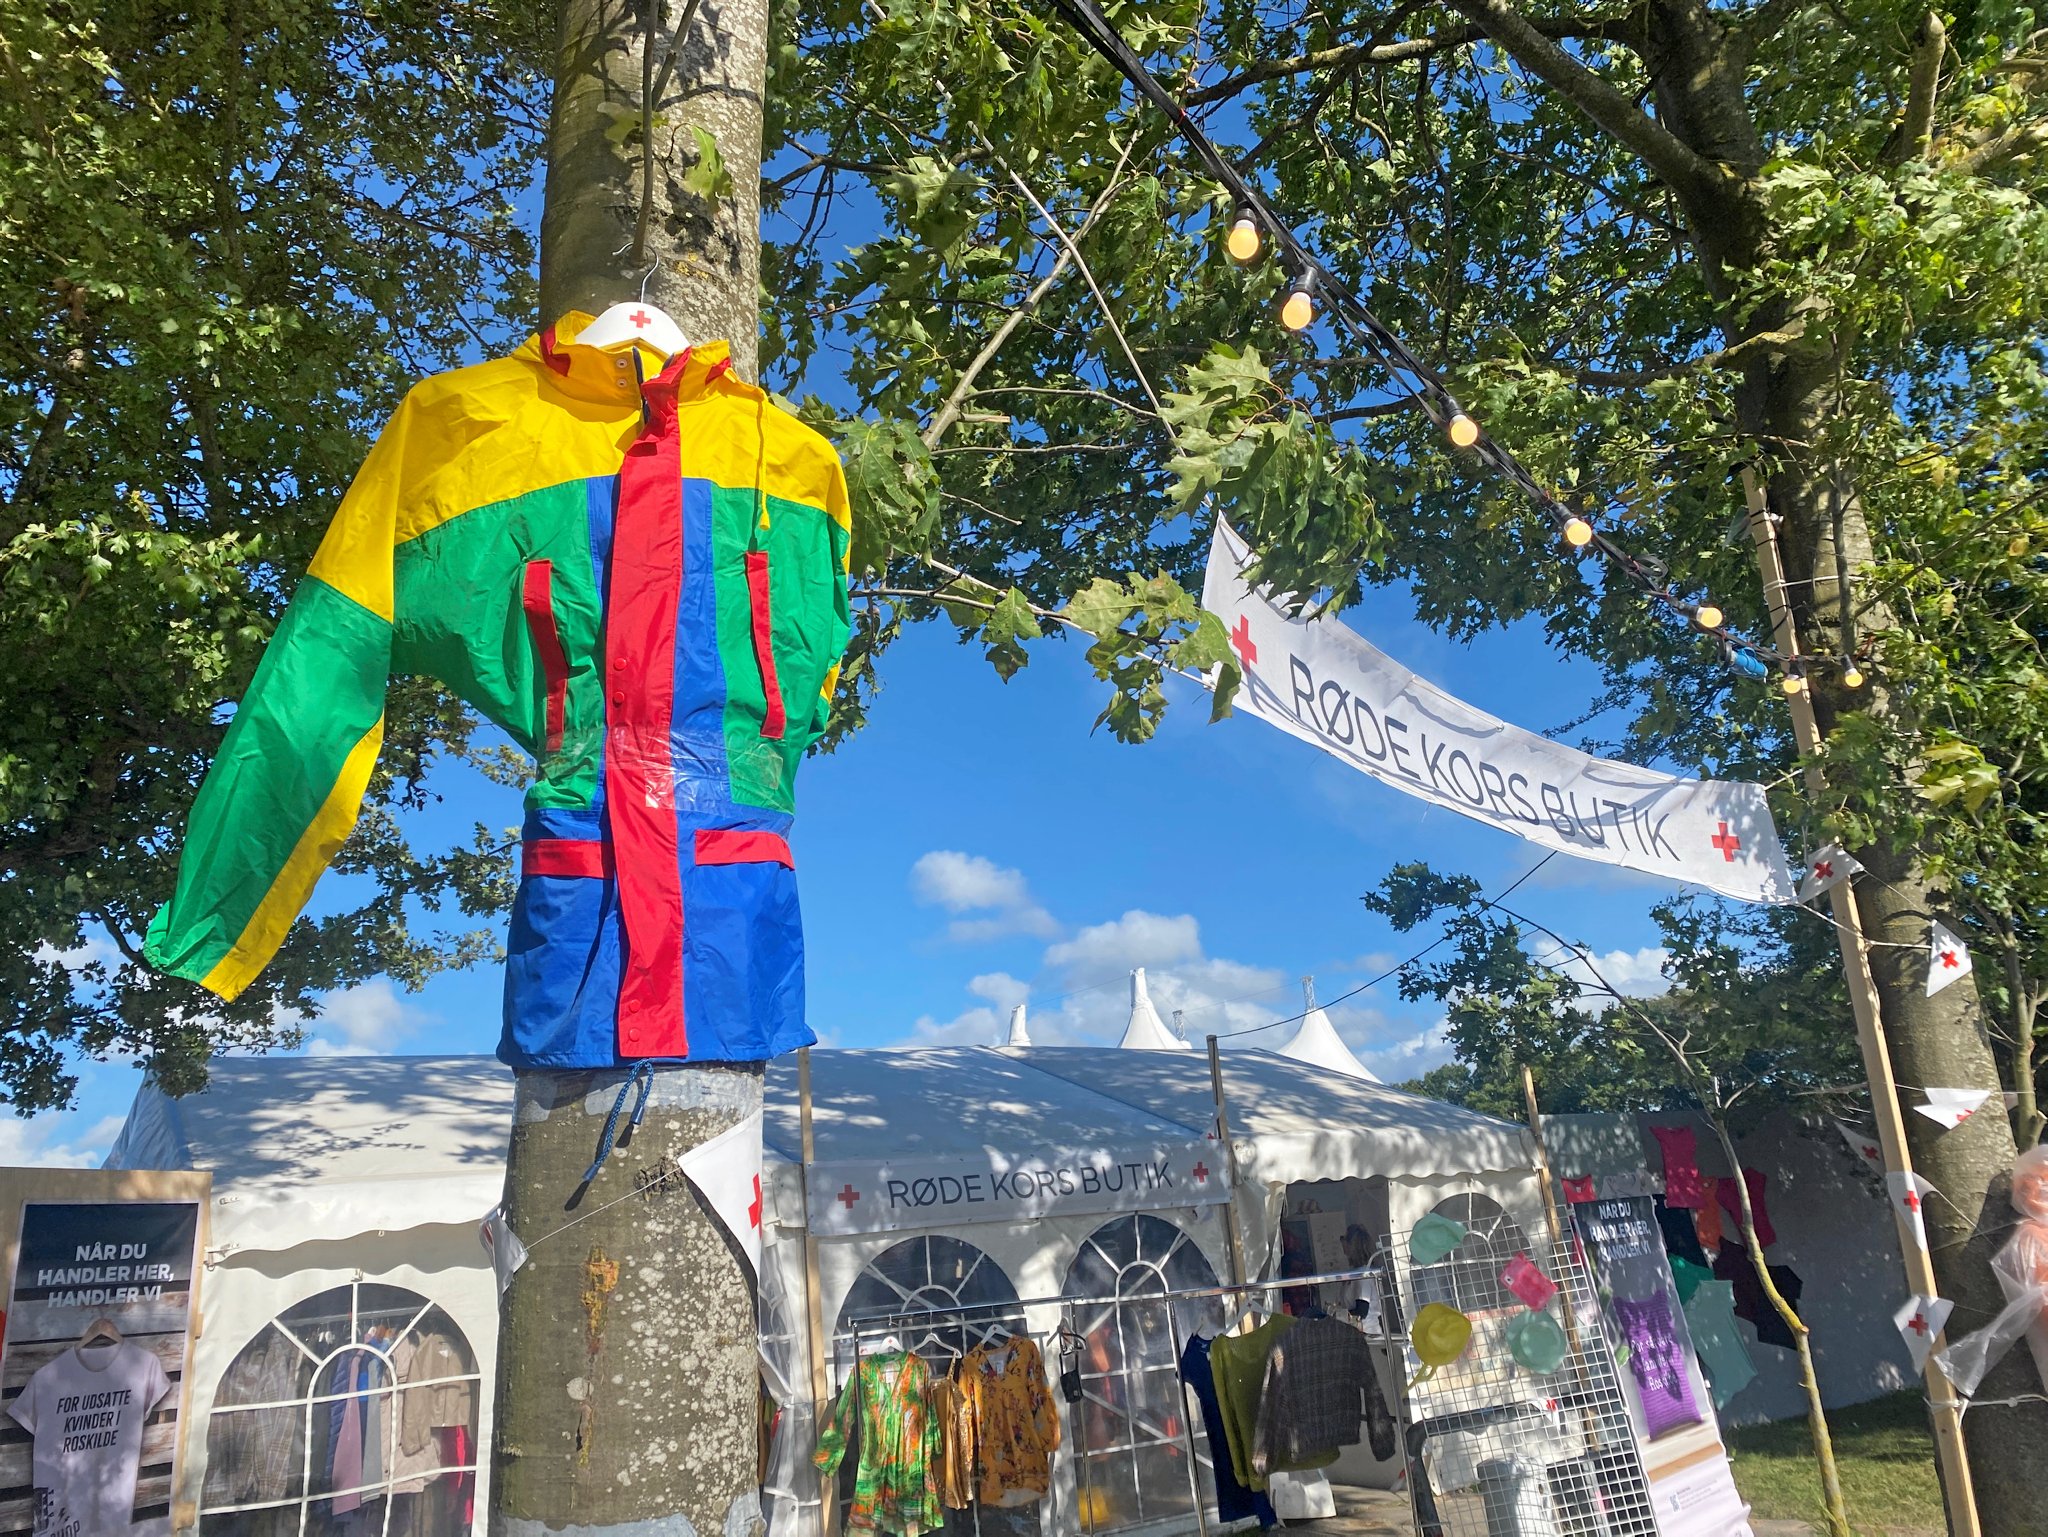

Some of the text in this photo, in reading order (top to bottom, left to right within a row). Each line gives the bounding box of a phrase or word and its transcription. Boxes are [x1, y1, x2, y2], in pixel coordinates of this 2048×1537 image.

[1289, 652, 1682, 862] RØDE KORS BUTIK
[887, 1161, 1173, 1208] RØDE KORS BUTIK
[1599, 1202, 1631, 1220] NÅR DU
[1590, 1221, 1652, 1242] HANDLER HER,
[76, 1241, 146, 1261] NÅR DU
[1642, 1241, 1652, 1255] VI
[38, 1263, 174, 1286] HANDLER HER,
[49, 1285, 161, 1308] HANDLER VI
[57, 1389, 131, 1414] FOR UDSATTE
[64, 1410, 121, 1433] KVINDER I
[63, 1430, 119, 1453] ROSKILDE
[50, 1519, 80, 1537] OP
